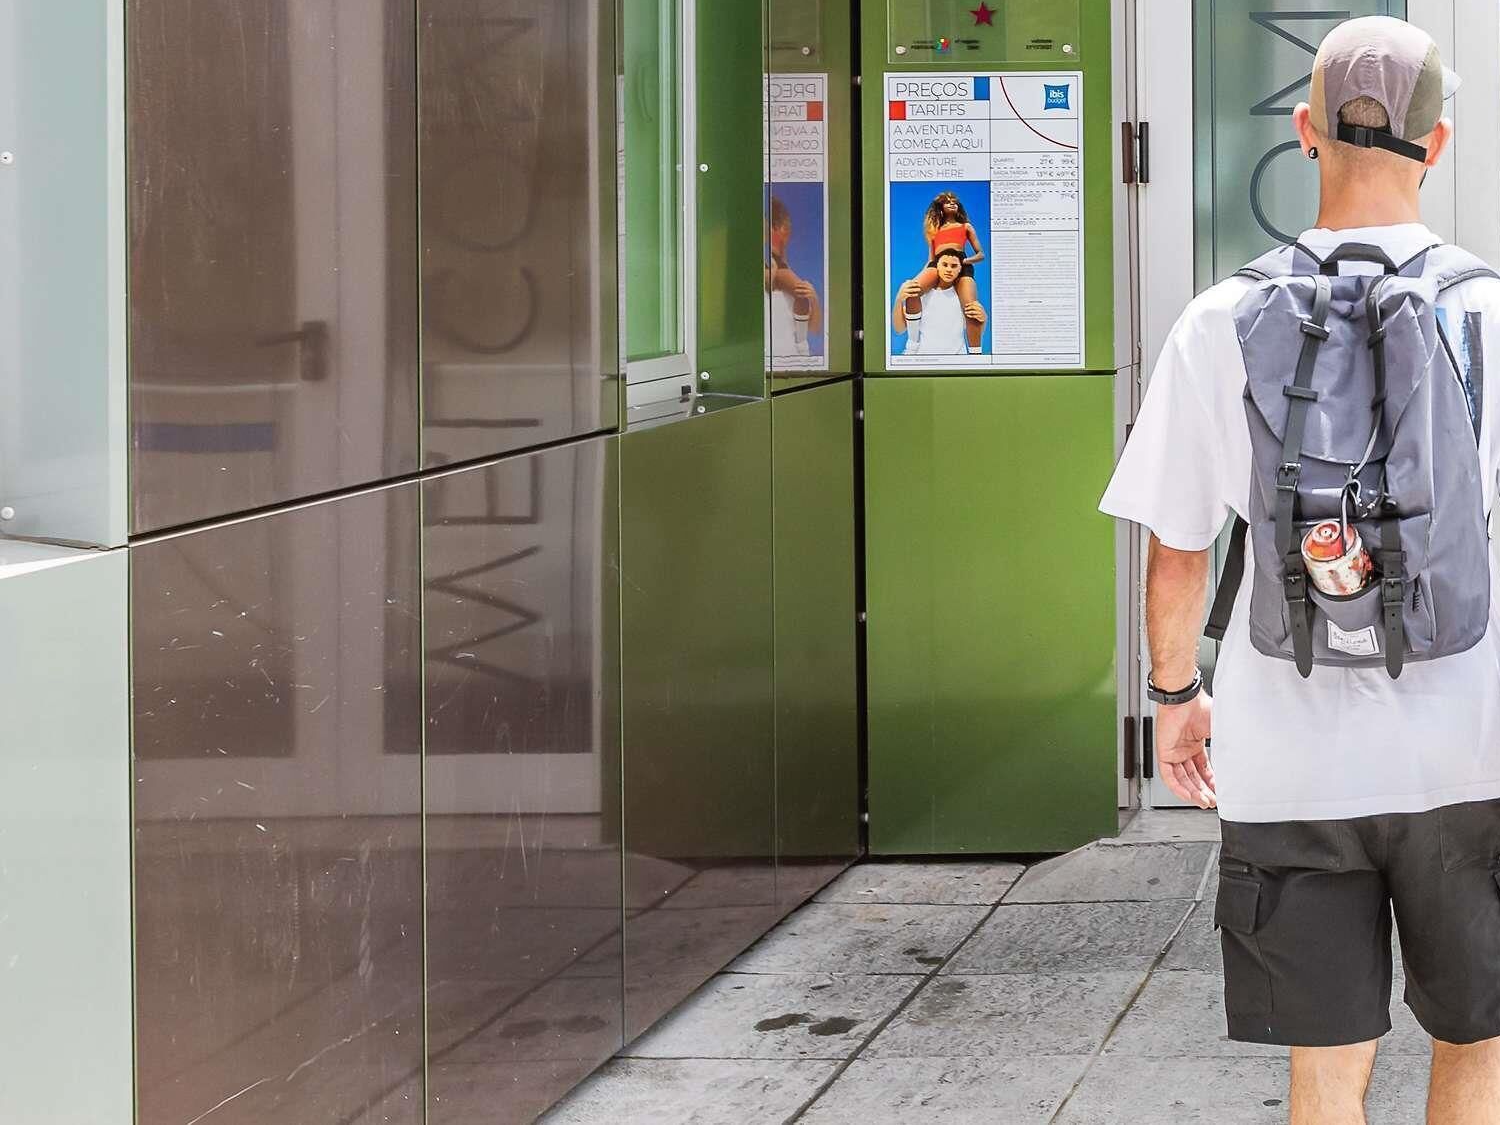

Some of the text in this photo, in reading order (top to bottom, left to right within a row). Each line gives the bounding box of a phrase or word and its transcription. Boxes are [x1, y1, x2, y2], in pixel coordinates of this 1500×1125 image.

[896, 82, 969, 102] PREÇOS
[909, 104, 967, 116] TARIFFS
[894, 124, 974, 135] A AVENTURA
[893, 138, 984, 151] COMEÇA AQUI
[896, 157, 958, 167] ADVENTURE
[896, 169, 965, 178] BEGINS HERE
